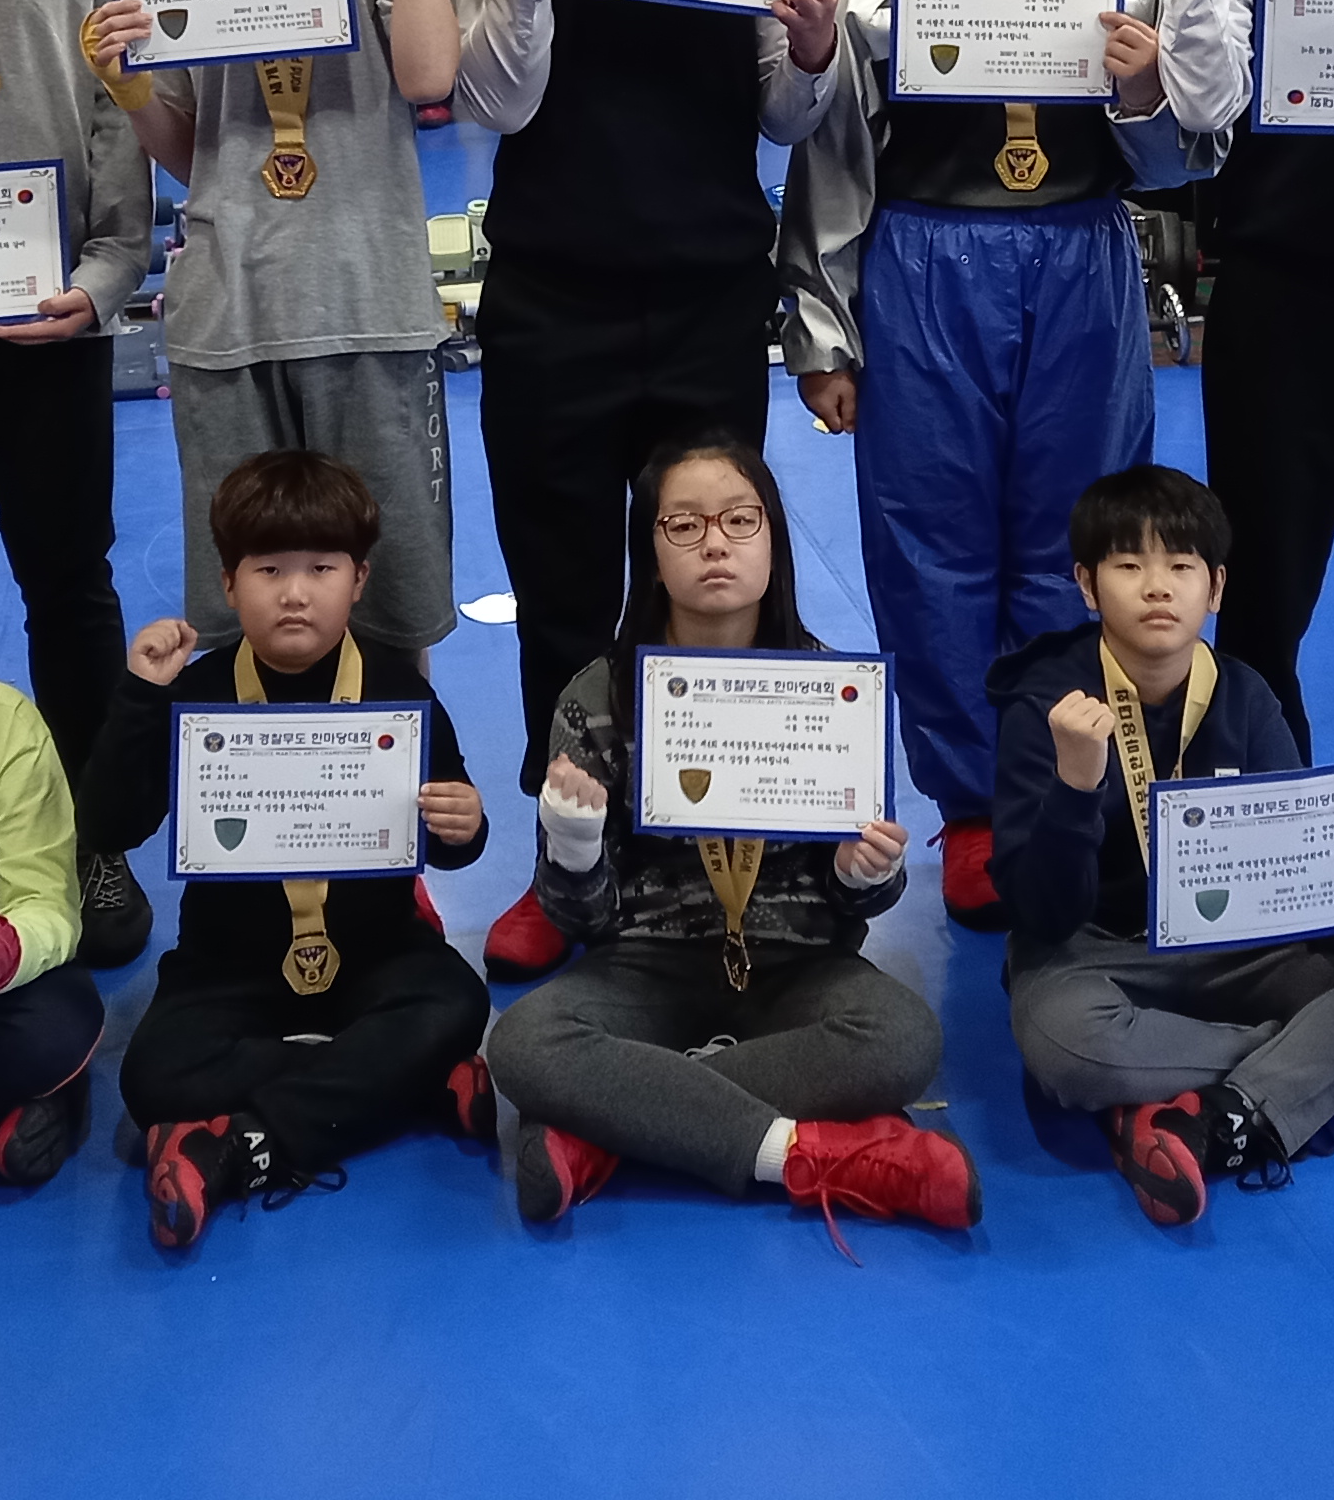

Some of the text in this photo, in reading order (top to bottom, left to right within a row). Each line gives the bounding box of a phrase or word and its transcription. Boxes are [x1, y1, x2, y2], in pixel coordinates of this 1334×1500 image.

[692, 678, 717, 692] 세계
[229, 733, 254, 746] 세계
[1210, 804, 1235, 818] 세계
